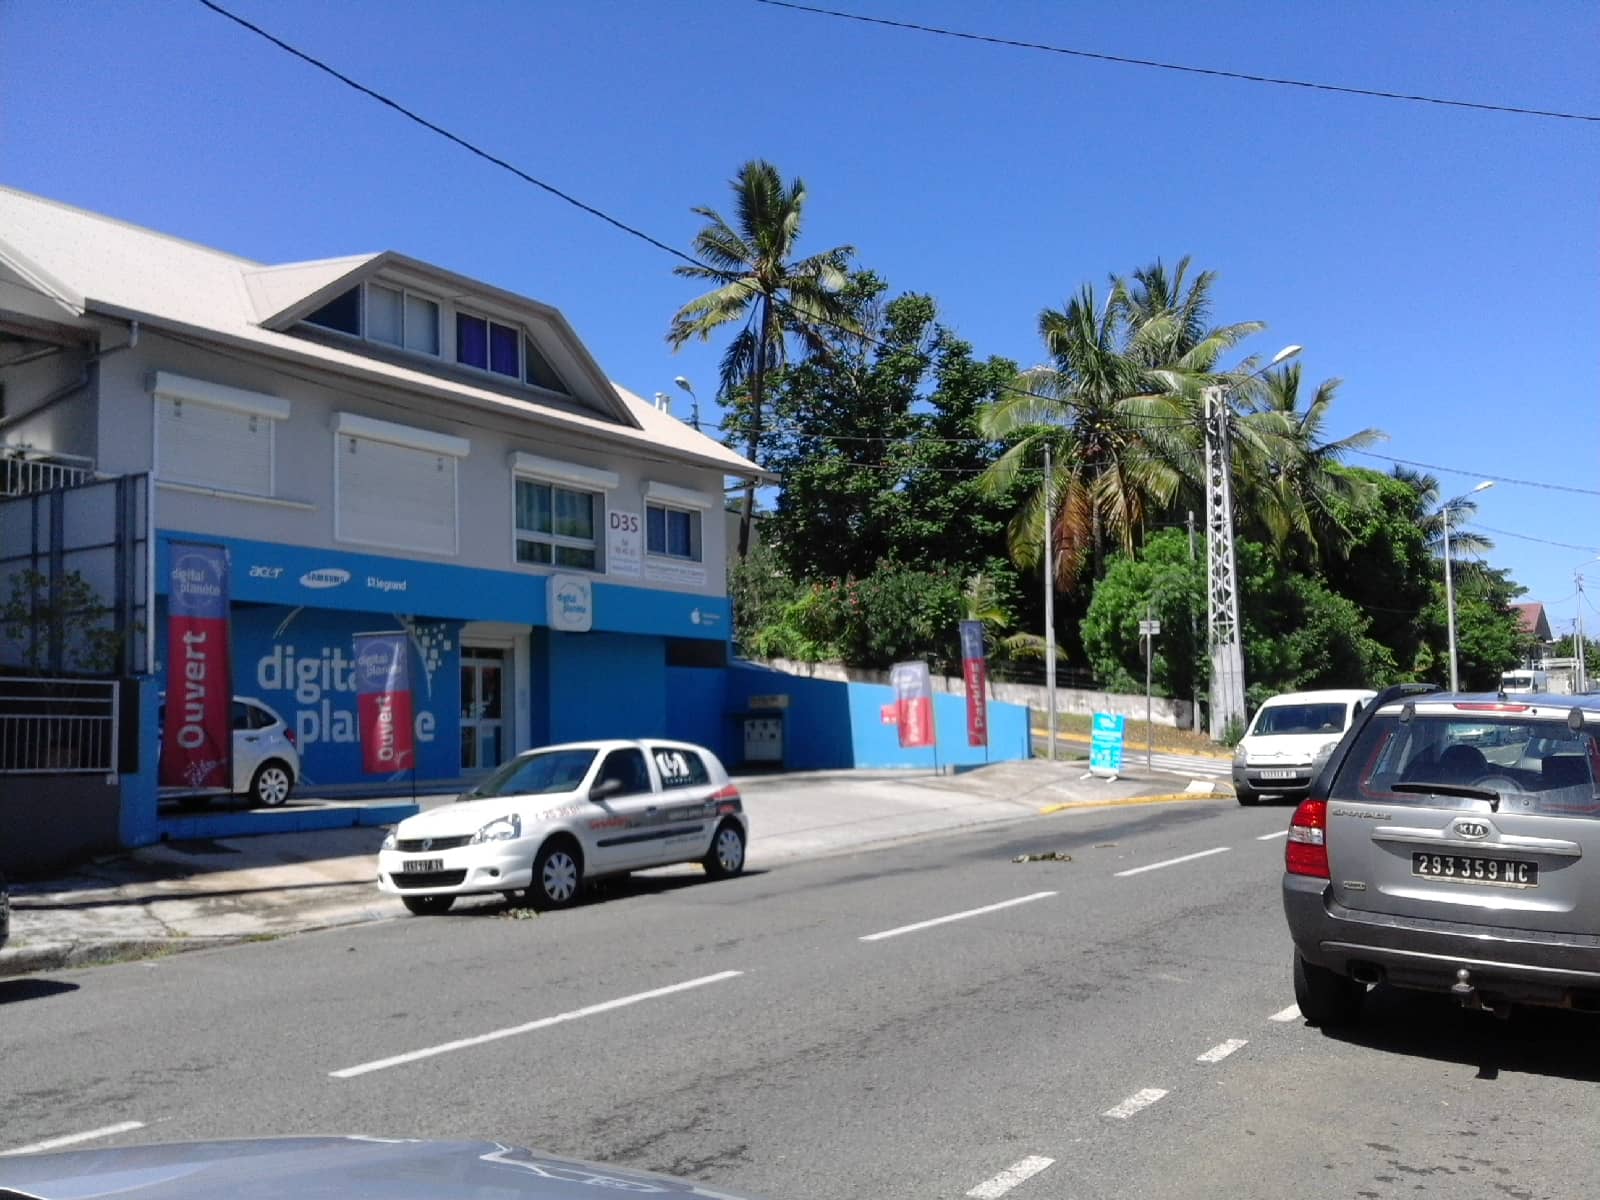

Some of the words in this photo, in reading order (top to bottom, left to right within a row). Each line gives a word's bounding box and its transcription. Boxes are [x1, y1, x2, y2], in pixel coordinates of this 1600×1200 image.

[610, 512, 638, 533] D3S
[249, 566, 283, 579] acer
[177, 630, 207, 750] Ouvert
[257, 645, 357, 703] digit
[296, 699, 436, 756] plae
[375, 695, 394, 761] Ouvert
[1459, 824, 1484, 835] KIA
[1419, 855, 1454, 875] 293
[1461, 858, 1498, 879] 359
[1505, 862, 1528, 882] NC
